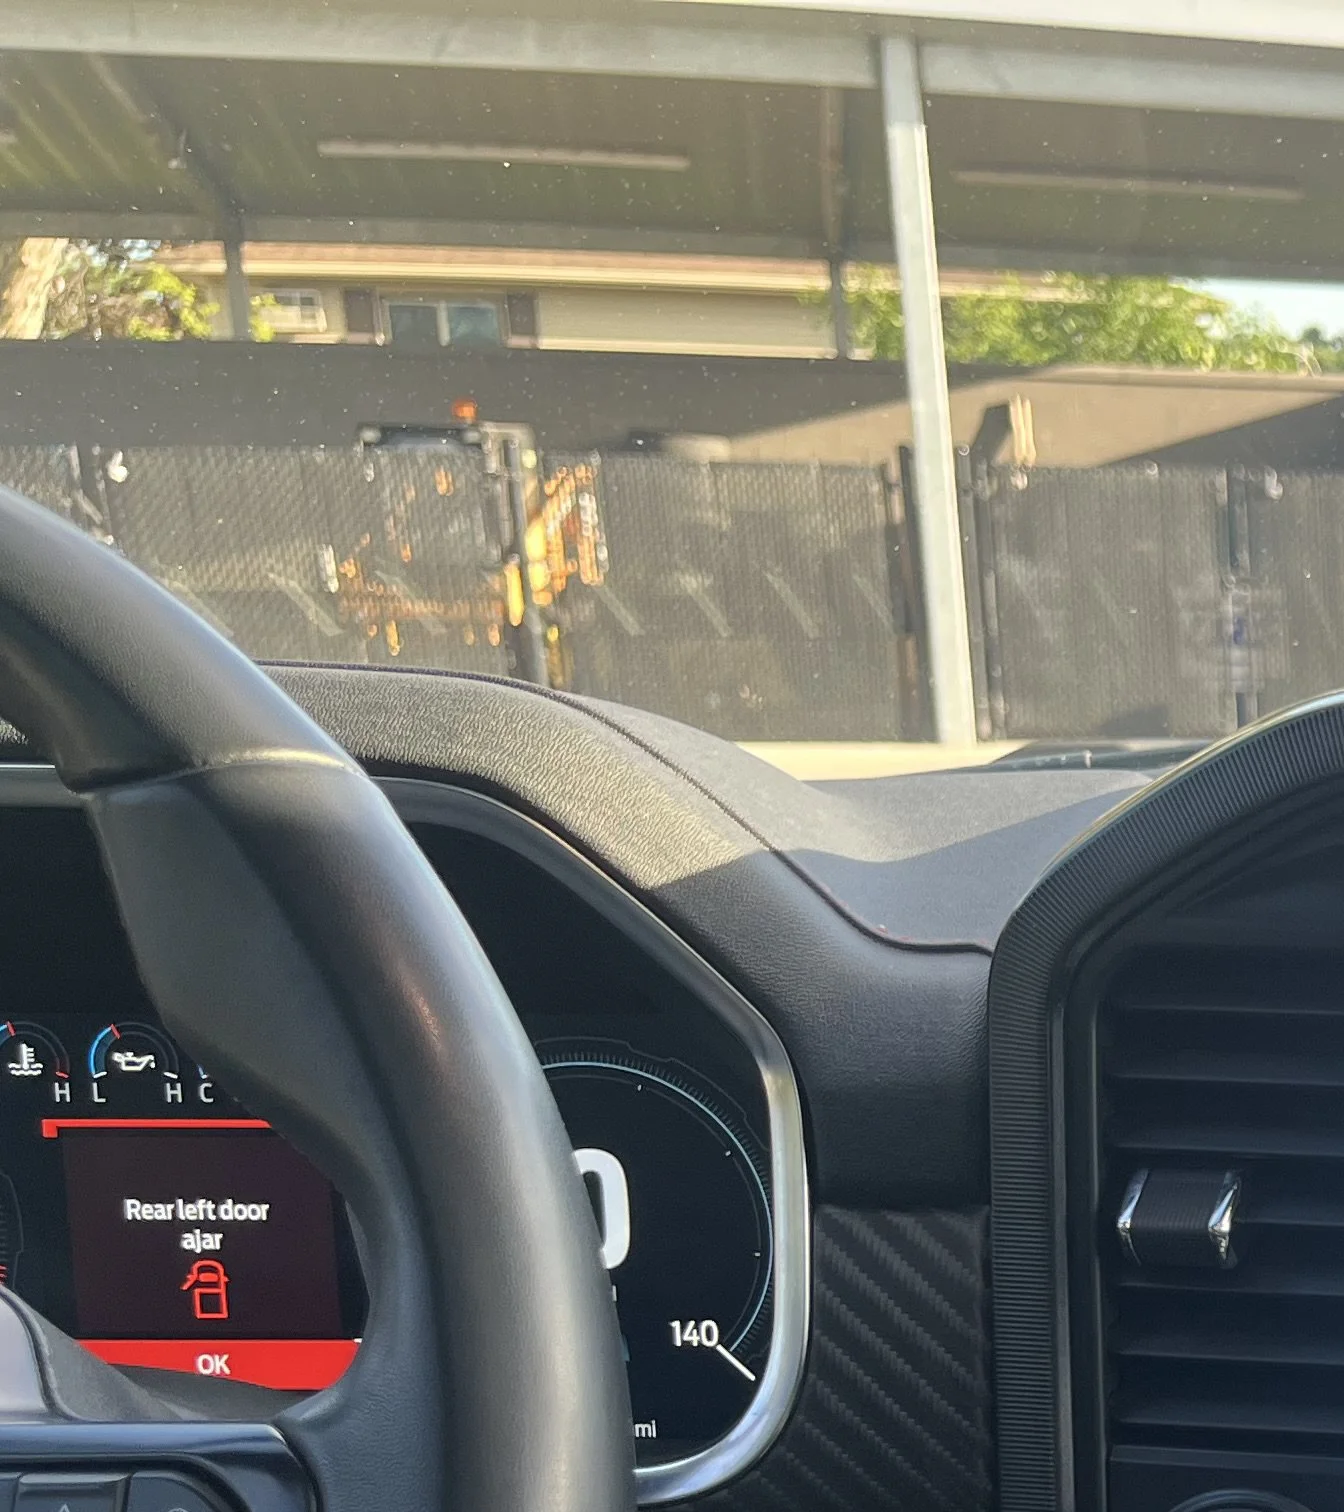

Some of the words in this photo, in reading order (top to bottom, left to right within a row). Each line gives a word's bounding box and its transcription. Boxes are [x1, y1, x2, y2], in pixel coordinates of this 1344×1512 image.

[54, 1083, 71, 1103] H
[92, 1083, 106, 1103] L
[166, 1083, 183, 1103] H
[198, 1083, 214, 1103] C
[124, 1199, 175, 1221] Rear
[176, 1199, 216, 1221] left
[220, 1199, 270, 1221] door
[181, 1230, 224, 1254] ajar
[669, 1319, 720, 1347] 140
[197, 1354, 231, 1376] OK
